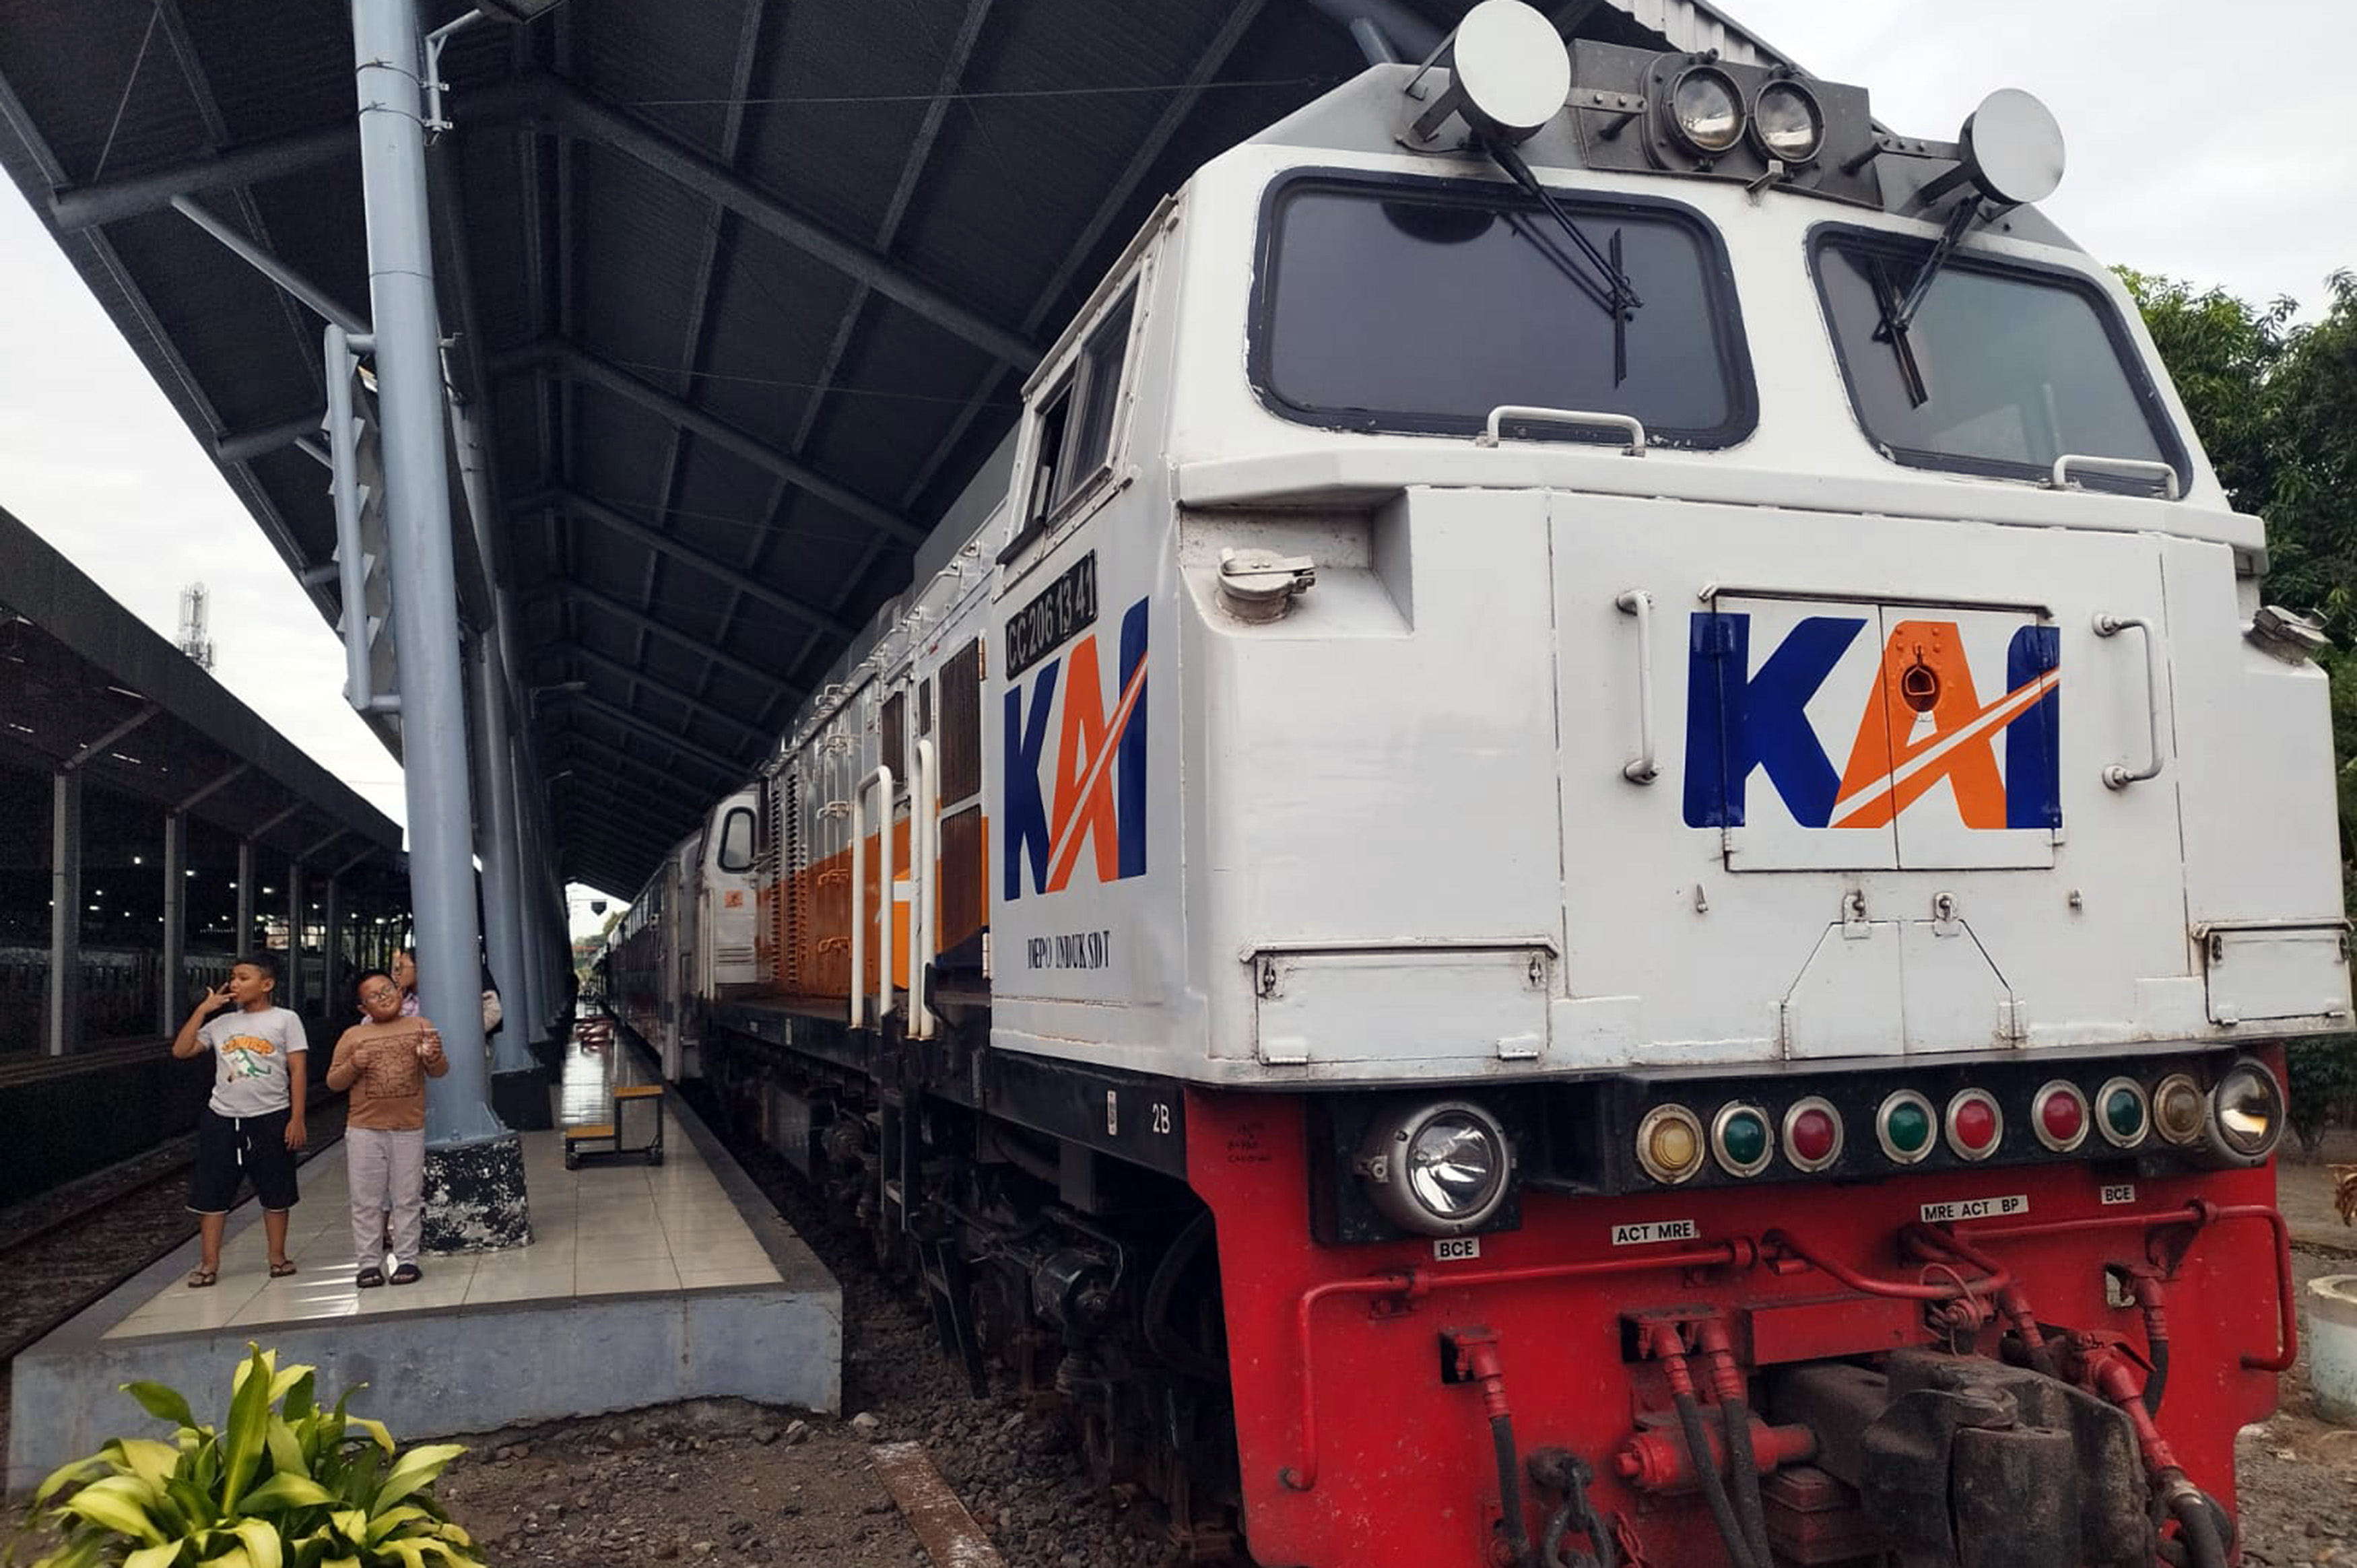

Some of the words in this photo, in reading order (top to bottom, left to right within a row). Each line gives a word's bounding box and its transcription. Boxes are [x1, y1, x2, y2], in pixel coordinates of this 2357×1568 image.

[1008, 617, 1027, 669] CC
[1029, 594, 1053, 656] 206
[1056, 580, 1072, 635] 13
[1076, 559, 1094, 618] 41
[1683, 611, 2062, 829] KAI
[1004, 595, 1149, 901] KAI
[1088, 930, 1110, 969] SDT
[1152, 1103, 1170, 1134] 2B
[1924, 1205, 1954, 1221] MRE
[1962, 1202, 1989, 1217] ACT
[2001, 1198, 2019, 1213] BP
[2106, 1187, 2131, 1202] BCE
[1617, 1226, 1650, 1242] ACT
[1658, 1223, 1691, 1239] MRE
[1440, 1241, 1473, 1257] BCE
